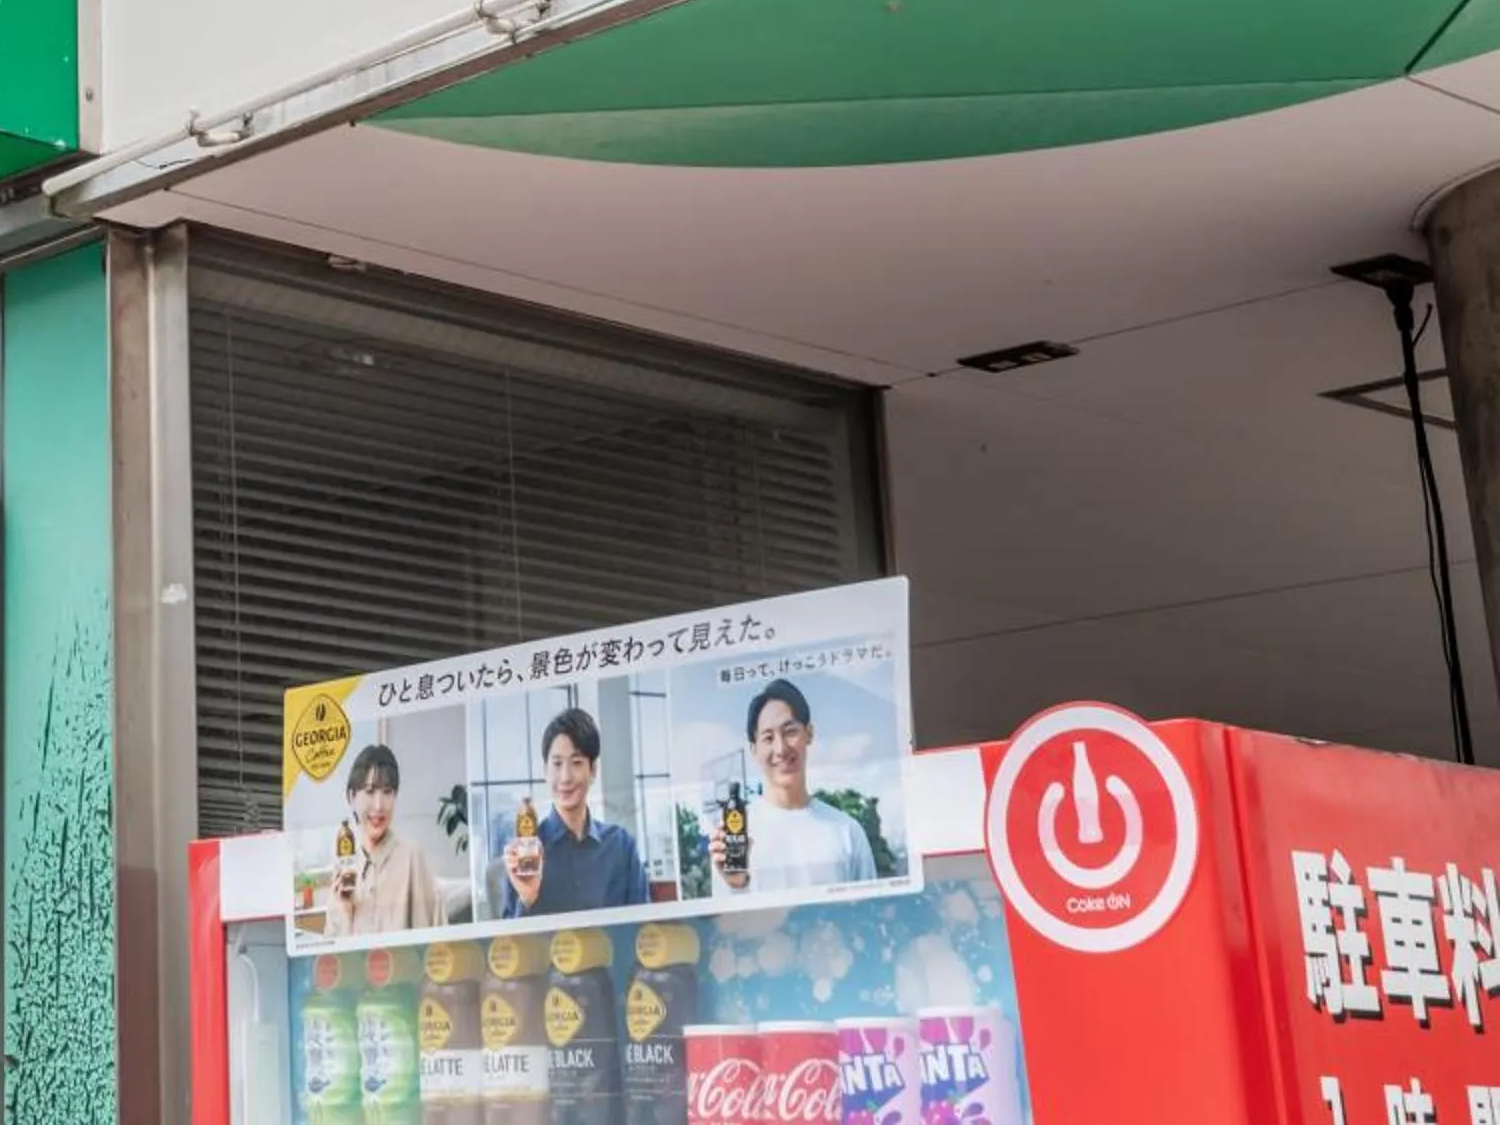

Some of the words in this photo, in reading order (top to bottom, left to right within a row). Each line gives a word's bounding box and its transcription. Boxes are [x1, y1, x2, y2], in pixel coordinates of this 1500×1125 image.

[377, 614, 776, 707] ひと息ついたら、景色が変わって見えた。
[295, 726, 347, 748] GEORGIA
[1066, 896, 1105, 914] Coke
[1107, 892, 1132, 911] ON
[556, 1047, 596, 1069] BLACK
[634, 1042, 674, 1065] BLACK
